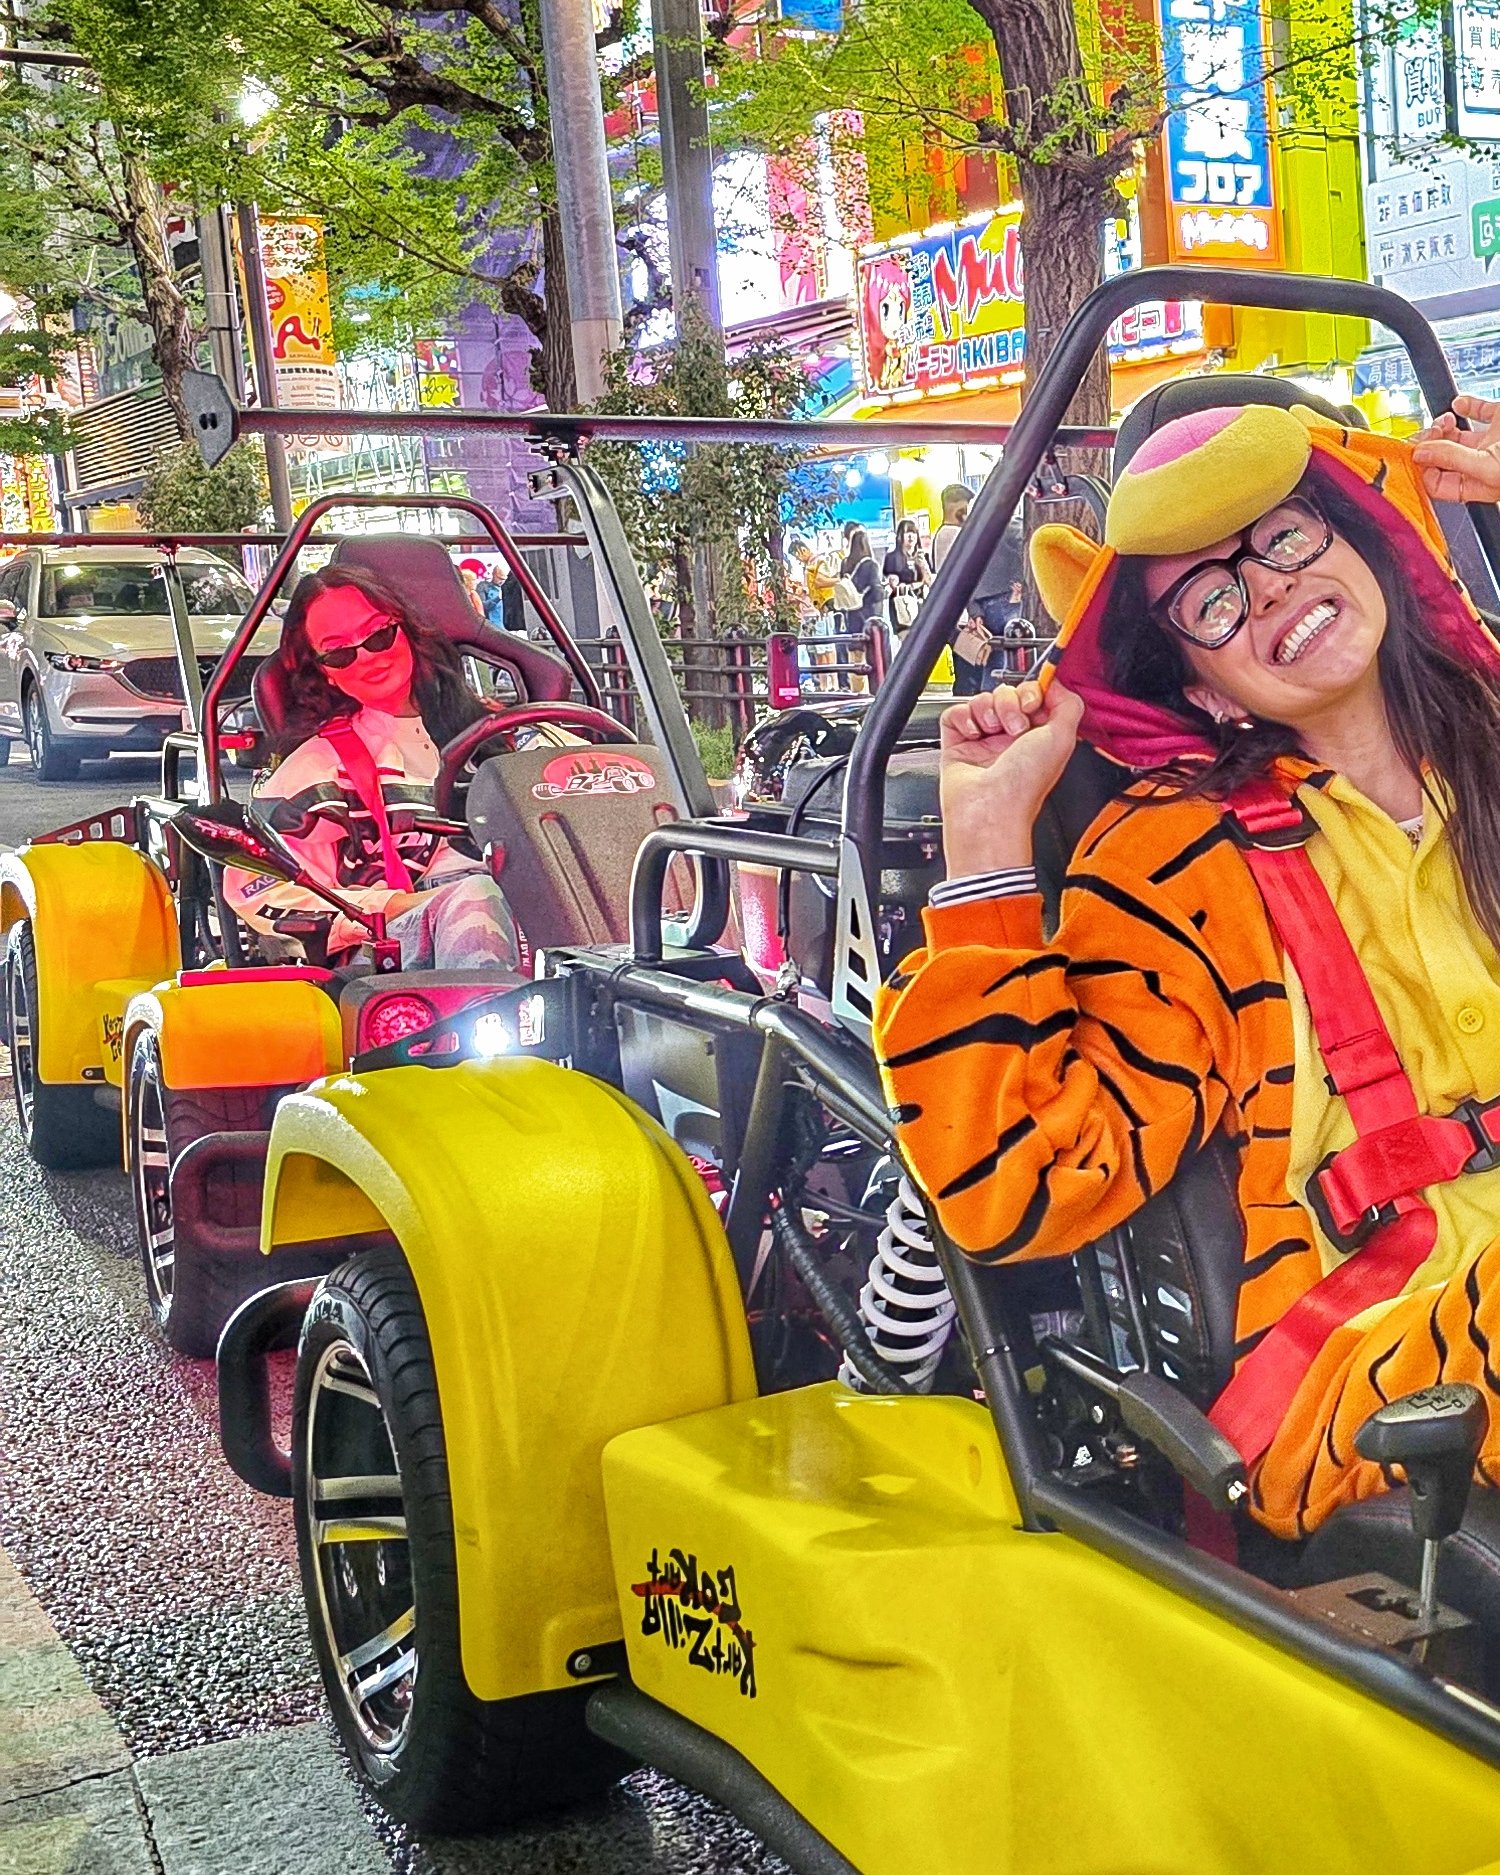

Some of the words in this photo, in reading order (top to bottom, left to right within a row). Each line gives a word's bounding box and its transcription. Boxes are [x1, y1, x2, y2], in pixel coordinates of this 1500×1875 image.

[1177, 160, 1263, 206] フロア
[959, 331, 1025, 372] AKIBA
